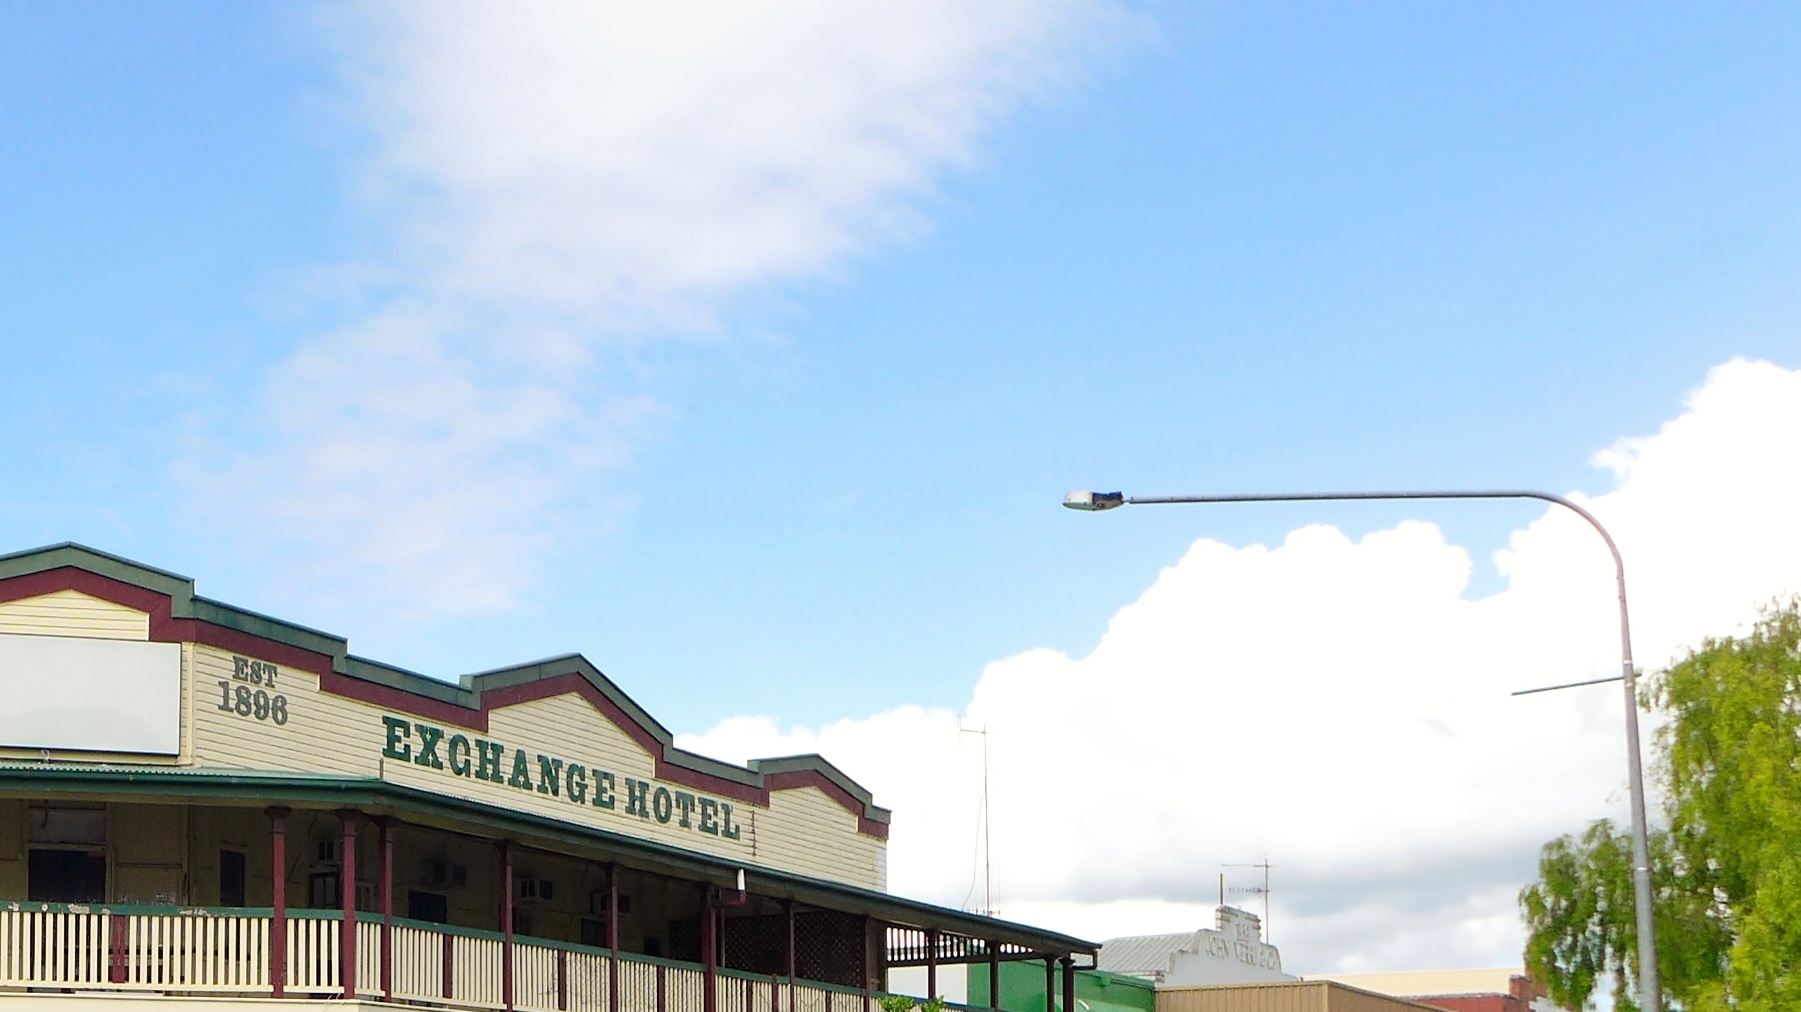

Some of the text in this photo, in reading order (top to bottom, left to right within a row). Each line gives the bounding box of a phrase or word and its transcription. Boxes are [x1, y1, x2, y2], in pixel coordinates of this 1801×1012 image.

[232, 655, 277, 688] EST
[218, 680, 288, 725] 1896
[381, 715, 740, 841] EXCHANGE HOTEL
